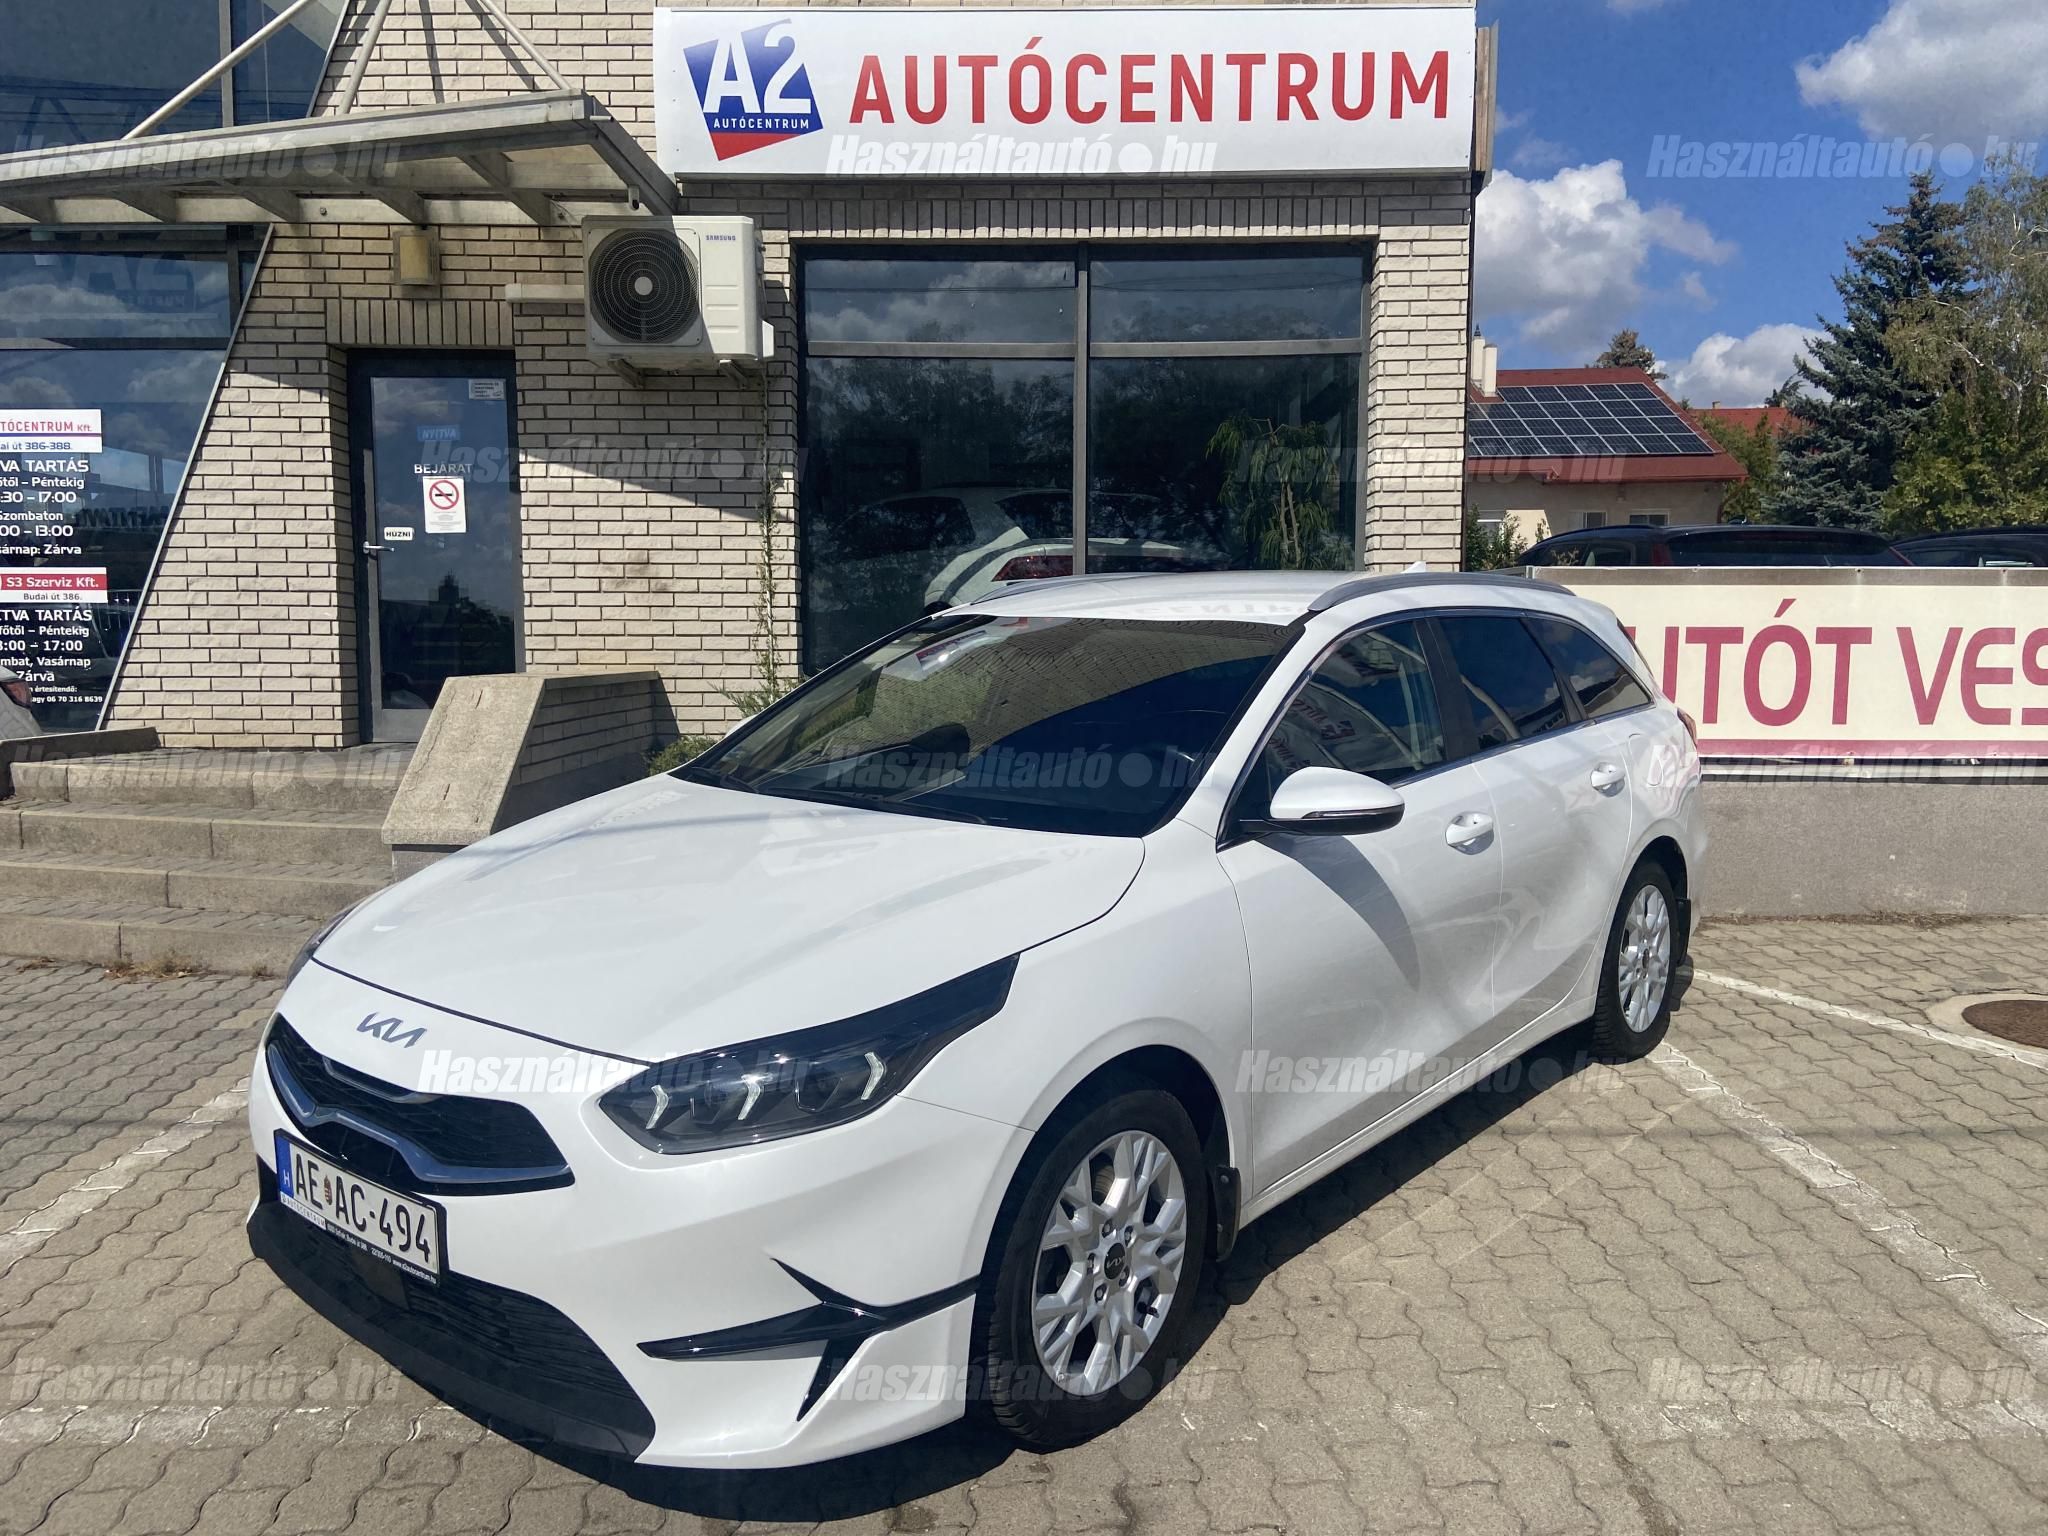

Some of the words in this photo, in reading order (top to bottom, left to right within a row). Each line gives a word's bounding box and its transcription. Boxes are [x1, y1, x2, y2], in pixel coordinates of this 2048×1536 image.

[703, 22, 811, 114] A2
[850, 37, 1448, 125] AUTÓCENTRUM
[713, 116, 809, 129] AUTÓCENTRUM
[422, 429, 457, 439] NYITVA
[25, 456, 89, 473] TARTÁS
[414, 461, 473, 474] BEJÁRAT
[31, 476, 85, 490] Péntekig
[38, 491, 77, 503] 17:00
[35, 525, 74, 537] 13:00
[43, 544, 82, 555] Zárva
[6, 577, 23, 587] S3
[26, 576, 73, 588] Szerviz
[76, 577, 99, 588] Kft.
[0, 609, 30, 621] TVA
[35, 606, 93, 621] TARTÁS
[39, 625, 90, 637] Péntekig
[43, 640, 83, 651] 17:00
[36, 656, 91, 668] Vasárnap
[16, 670, 55, 682] Zárva
[31, 696, 45, 704] agy
[283, 1169, 291, 1188] H
[296, 1153, 323, 1210] AE
[335, 1175, 431, 1263] AC-494
